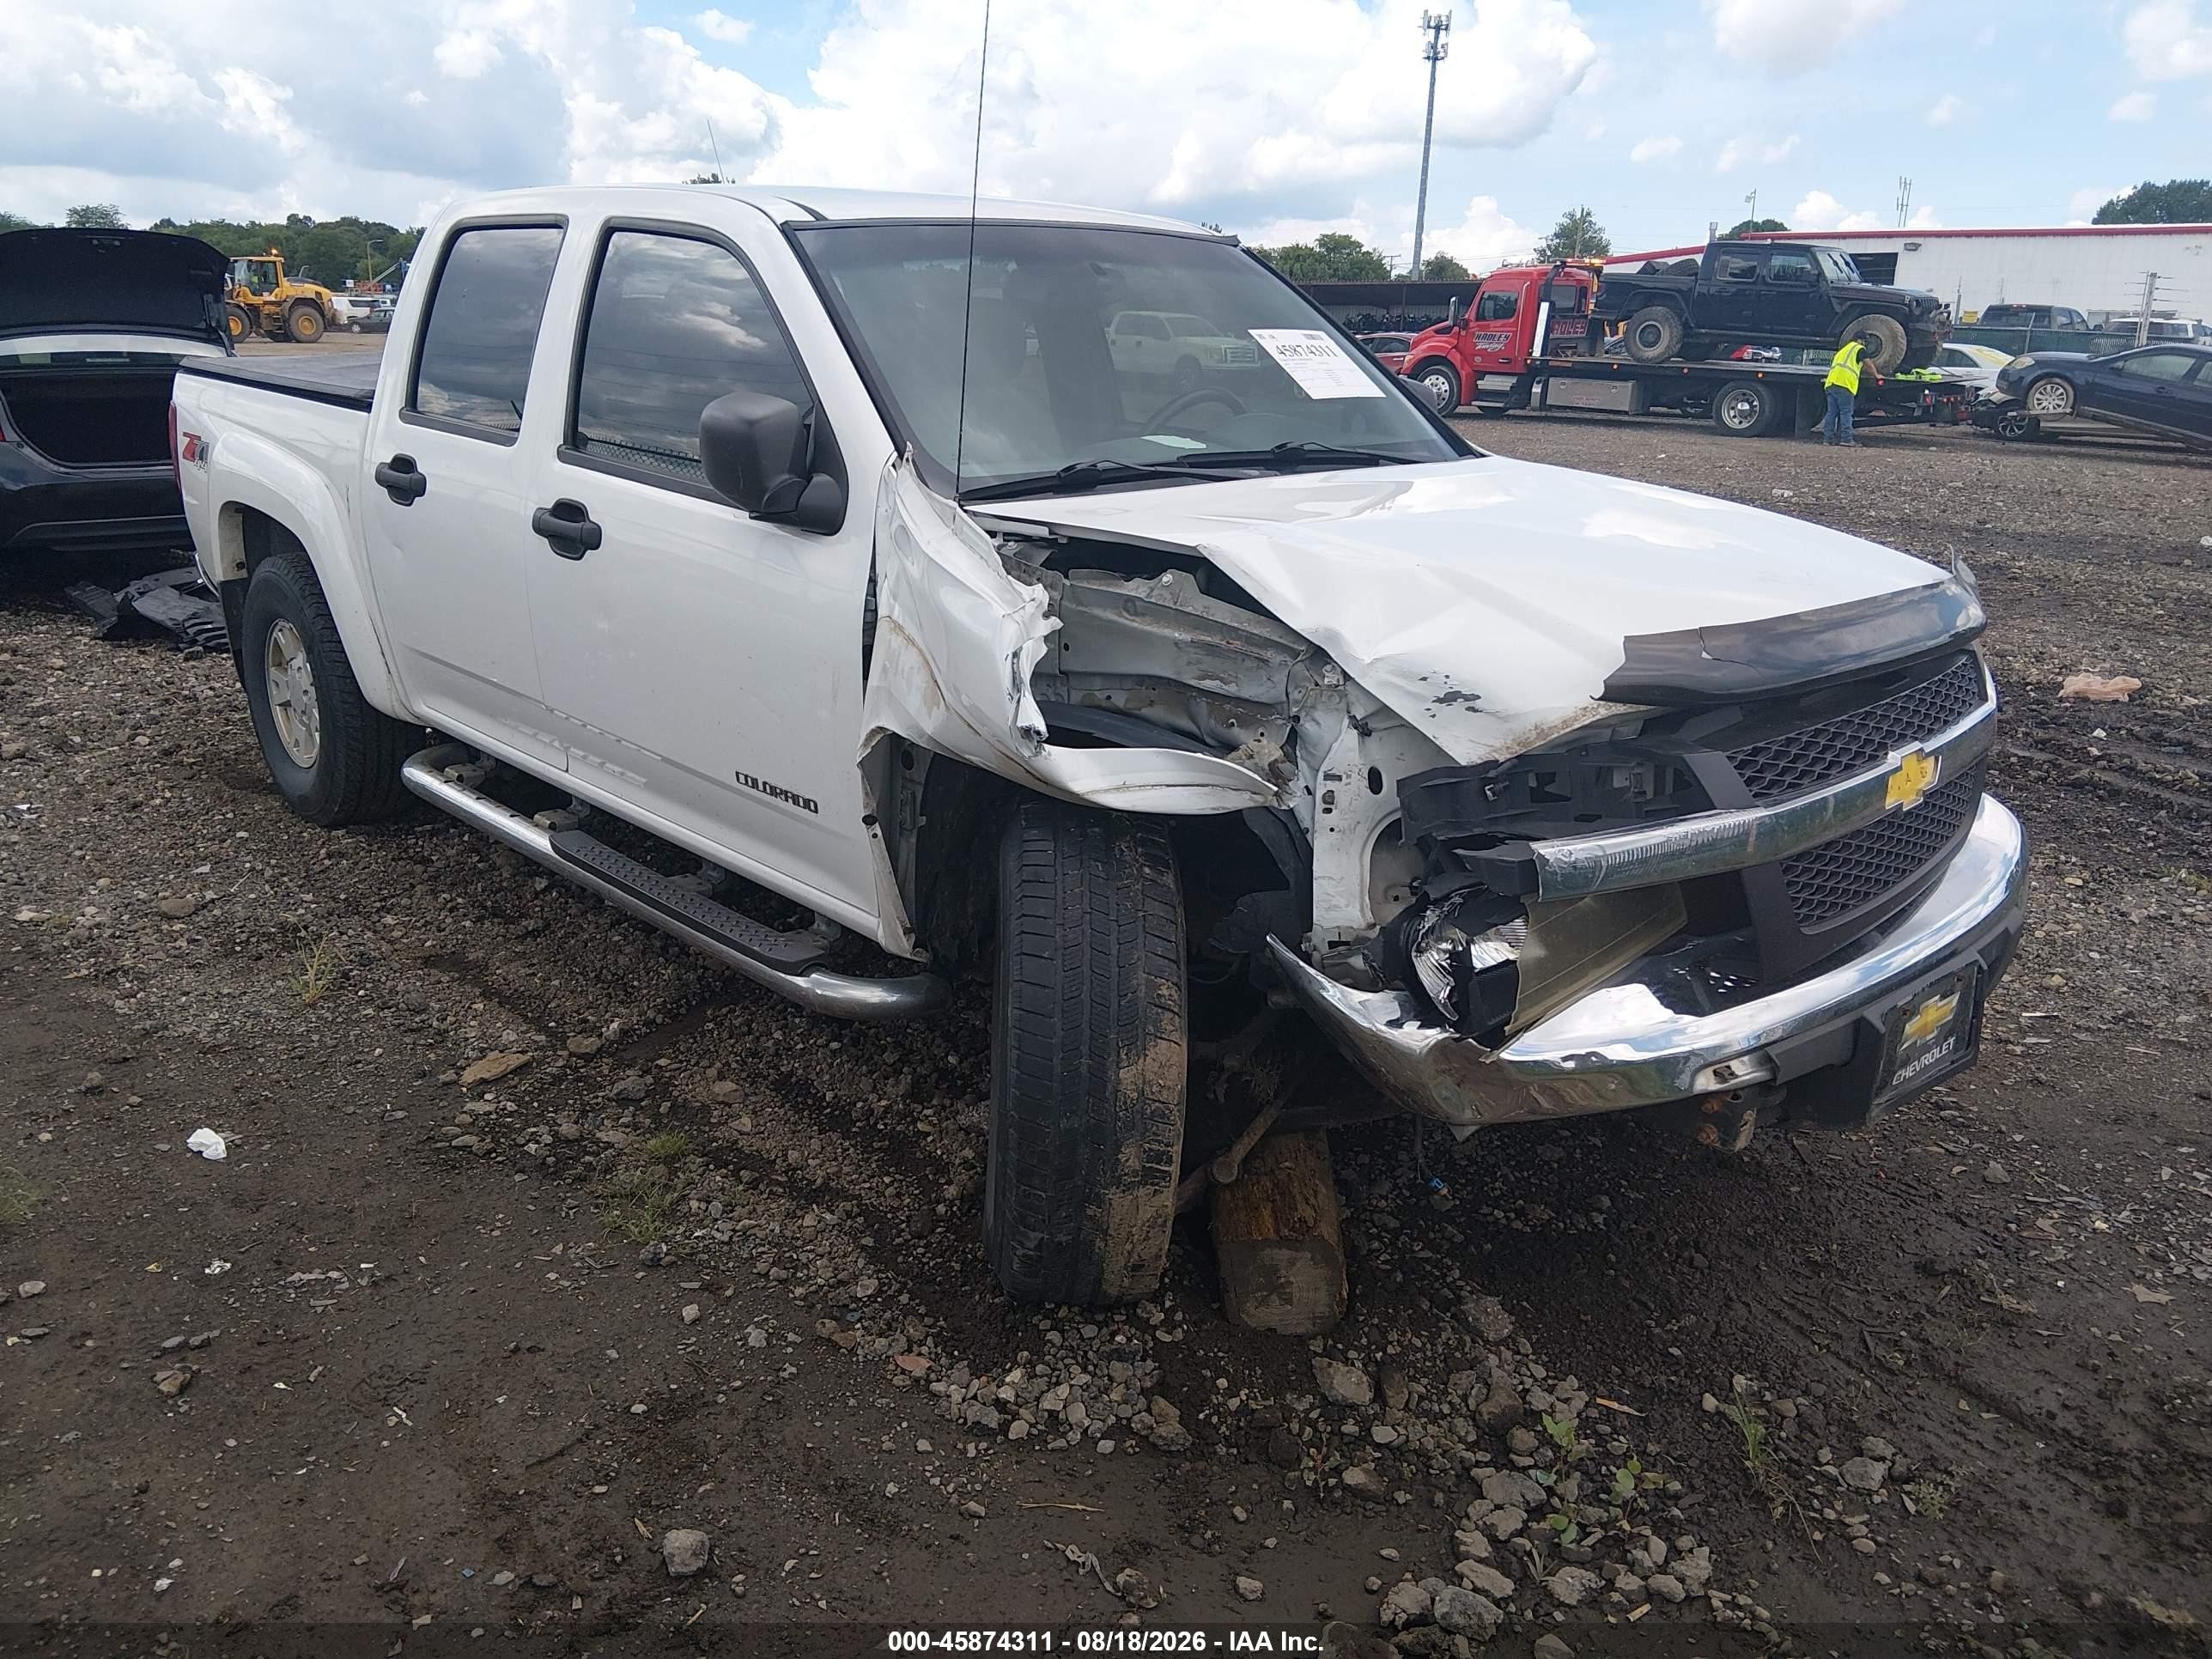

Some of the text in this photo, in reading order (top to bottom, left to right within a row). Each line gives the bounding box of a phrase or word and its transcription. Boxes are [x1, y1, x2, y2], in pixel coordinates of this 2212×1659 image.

[1551, 320, 1588, 336] ADLEY
[1474, 333, 1511, 342] HADLEY
[1275, 344, 1339, 358] 45874311
[735, 770, 819, 815] COLORADO
[1892, 1036, 1956, 1085] CHEVROLET
